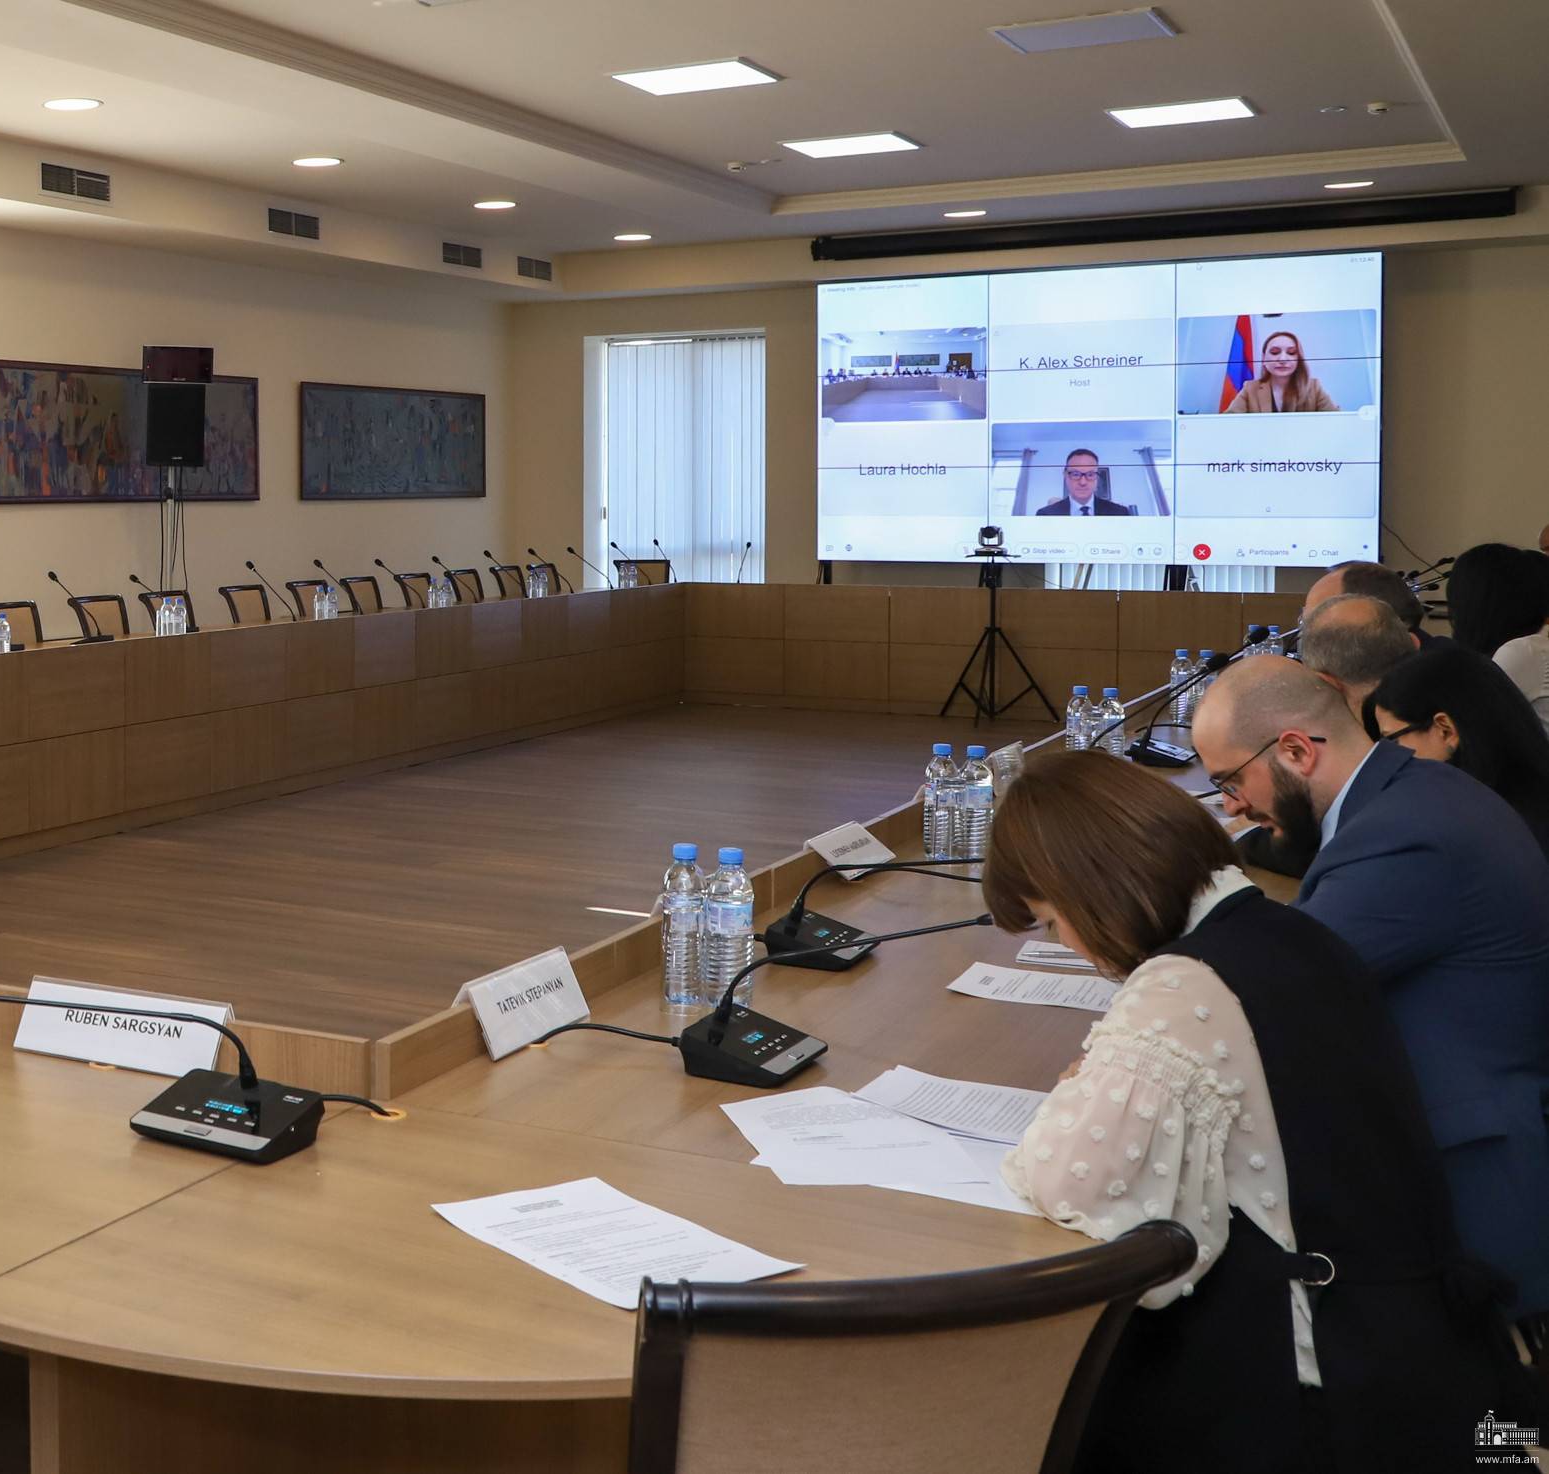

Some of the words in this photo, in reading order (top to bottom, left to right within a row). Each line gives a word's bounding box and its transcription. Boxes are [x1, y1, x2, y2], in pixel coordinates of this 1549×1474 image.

[1019, 357, 1033, 369] K.
[1037, 356, 1069, 369] Alex
[1073, 354, 1143, 367] Schreiner
[1069, 379, 1091, 387] Host
[859, 464, 896, 476] Laura
[901, 463, 947, 475] Hochla
[1207, 460, 1245, 473] mark
[1251, 458, 1343, 475] simakovsky
[1248, 548, 1290, 557] Participants
[1321, 549, 1339, 557] Chat
[496, 994, 528, 1015] TATEVIK
[525, 976, 565, 1002] STEPANYAN
[64, 1009, 110, 1027] RUBEN
[111, 1016, 183, 1039] SARGSYAN
